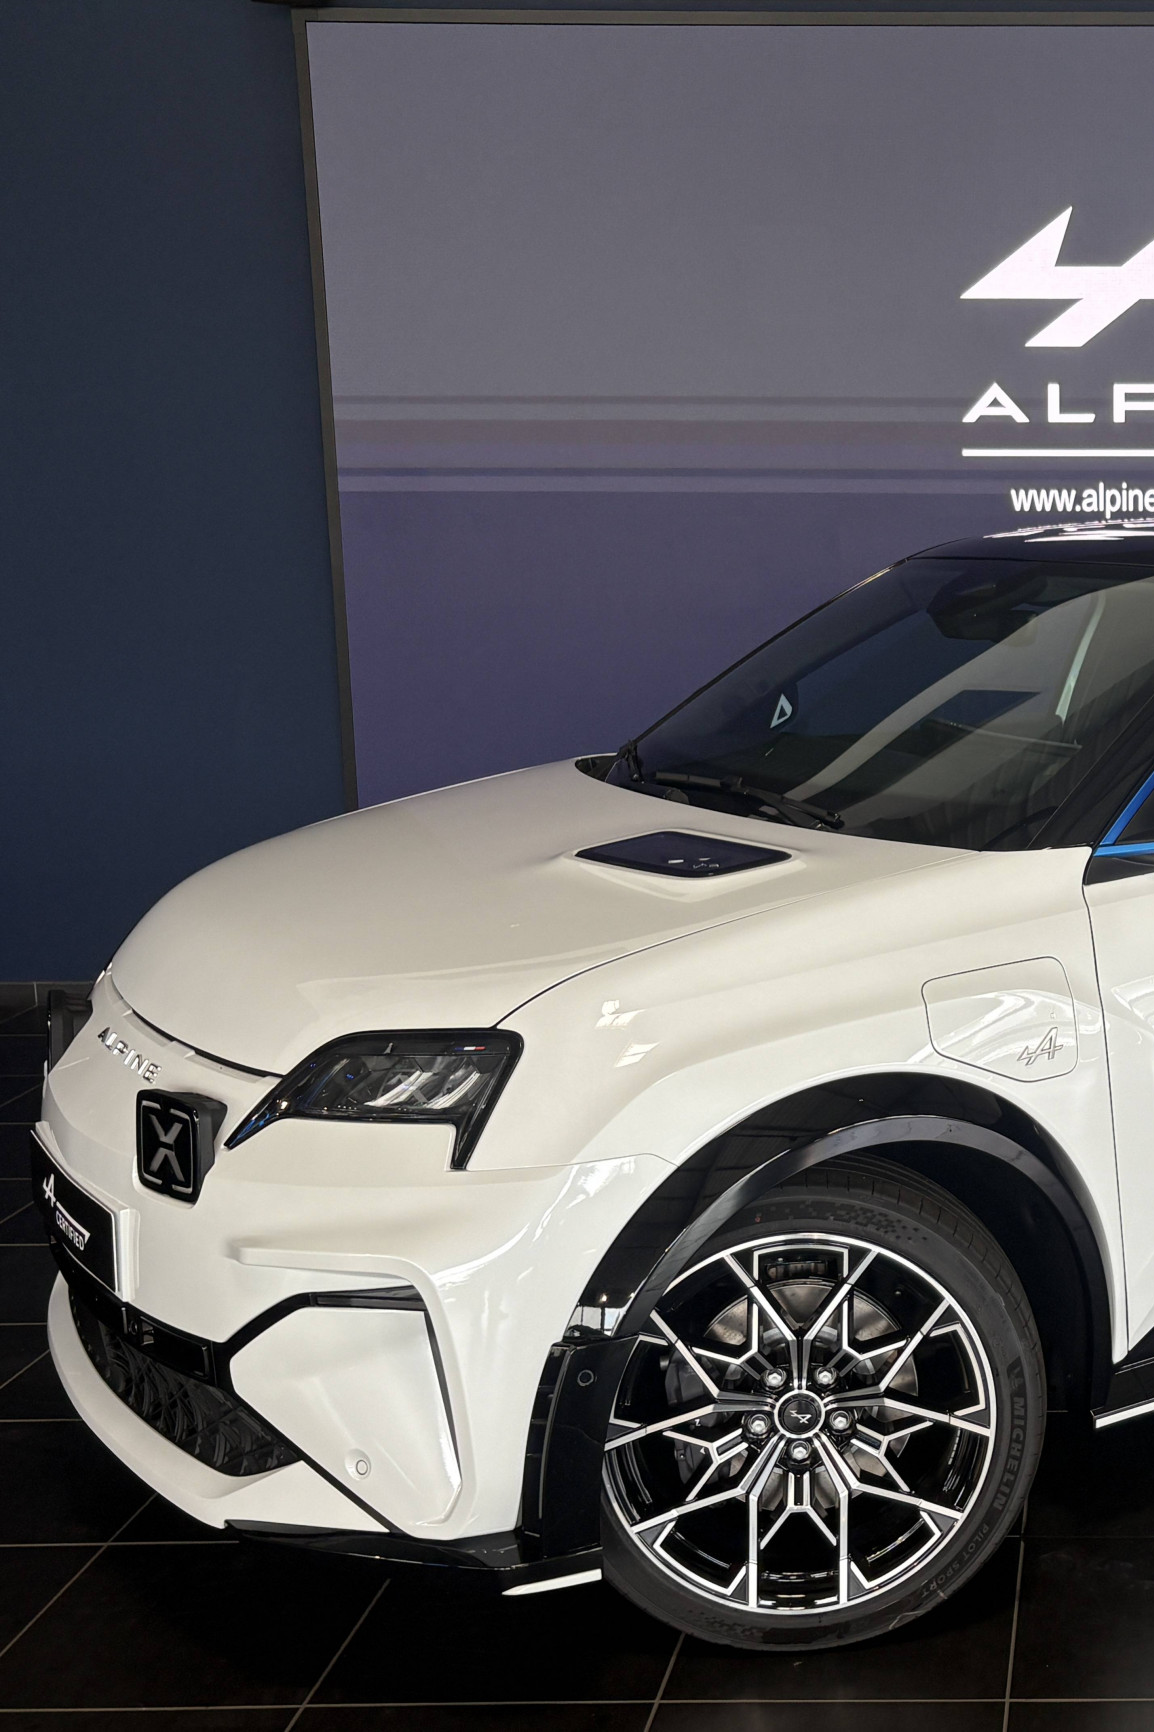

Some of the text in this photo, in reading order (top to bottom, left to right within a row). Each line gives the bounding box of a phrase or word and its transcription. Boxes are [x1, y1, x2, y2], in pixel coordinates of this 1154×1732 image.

[97, 1026, 162, 1084] ALPINE
[55, 1210, 85, 1251] CERTIFIED
[994, 1397, 1026, 1512] MICHELIN
[921, 1522, 990, 1598] PILOT SPORT
